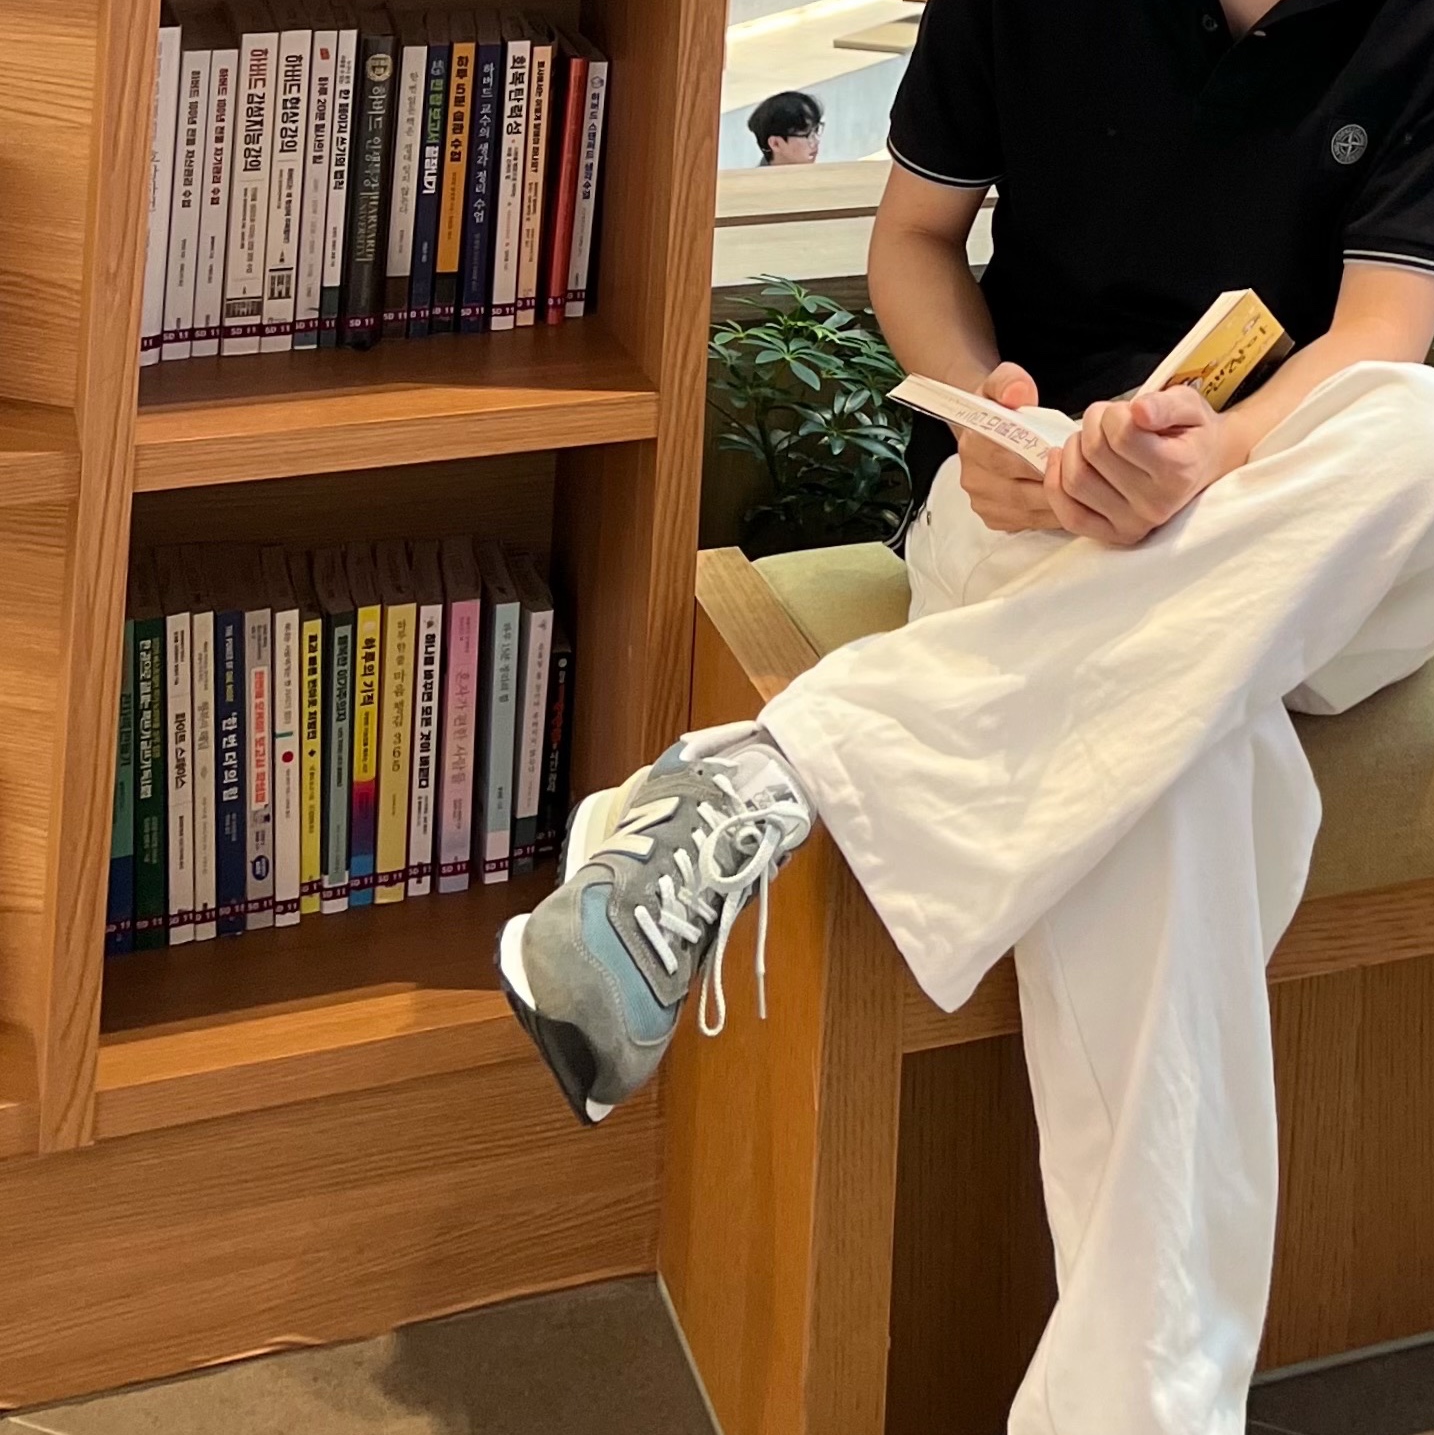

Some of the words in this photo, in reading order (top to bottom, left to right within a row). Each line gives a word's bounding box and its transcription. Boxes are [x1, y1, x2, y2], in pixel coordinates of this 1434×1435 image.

[248, 49, 269, 90] 하버드
[283, 54, 304, 95] 하버드
[456, 56, 469, 80] 하루
[480, 62, 495, 99] 하버드
[316, 77, 329, 96] 하루
[339, 89, 351, 100] 한
[505, 54, 526, 136] 회복탄력성
[314, 98, 328, 121] 20분
[368, 85, 387, 131] 하버드
[478, 103, 492, 138] 교수의
[427, 107, 442, 143] 보고서
[334, 136, 349, 167] 쓰기의
[449, 138, 462, 162] 수업
[473, 198, 486, 224] 수업
[355, 196, 367, 259] UNIVERSITY
[365, 196, 379, 259] HARVARD
[474, 307, 484, 315] 11
[163, 333, 175, 341] 5D
[178, 331, 189, 339] 11
[210, 329, 220, 337] 11
[265, 326, 277, 334] 5D
[280, 325, 290, 333] 11
[225, 638, 233, 660] POWER
[361, 637, 377, 678] 하루의
[424, 633, 436, 666] 하나를
[359, 681, 376, 707] 기적
[421, 669, 435, 703] 바꾸면
[454, 669, 471, 710] 혼자가
[420, 705, 434, 728] 모든
[222, 734, 238, 748] 번
[392, 732, 401, 772] 365
[418, 731, 433, 753] 것이
[417, 756, 431, 789] 바뀐다
[451, 744, 467, 784] 사람들
[222, 787, 239, 801] 힘
[456, 863, 467, 871] 11
